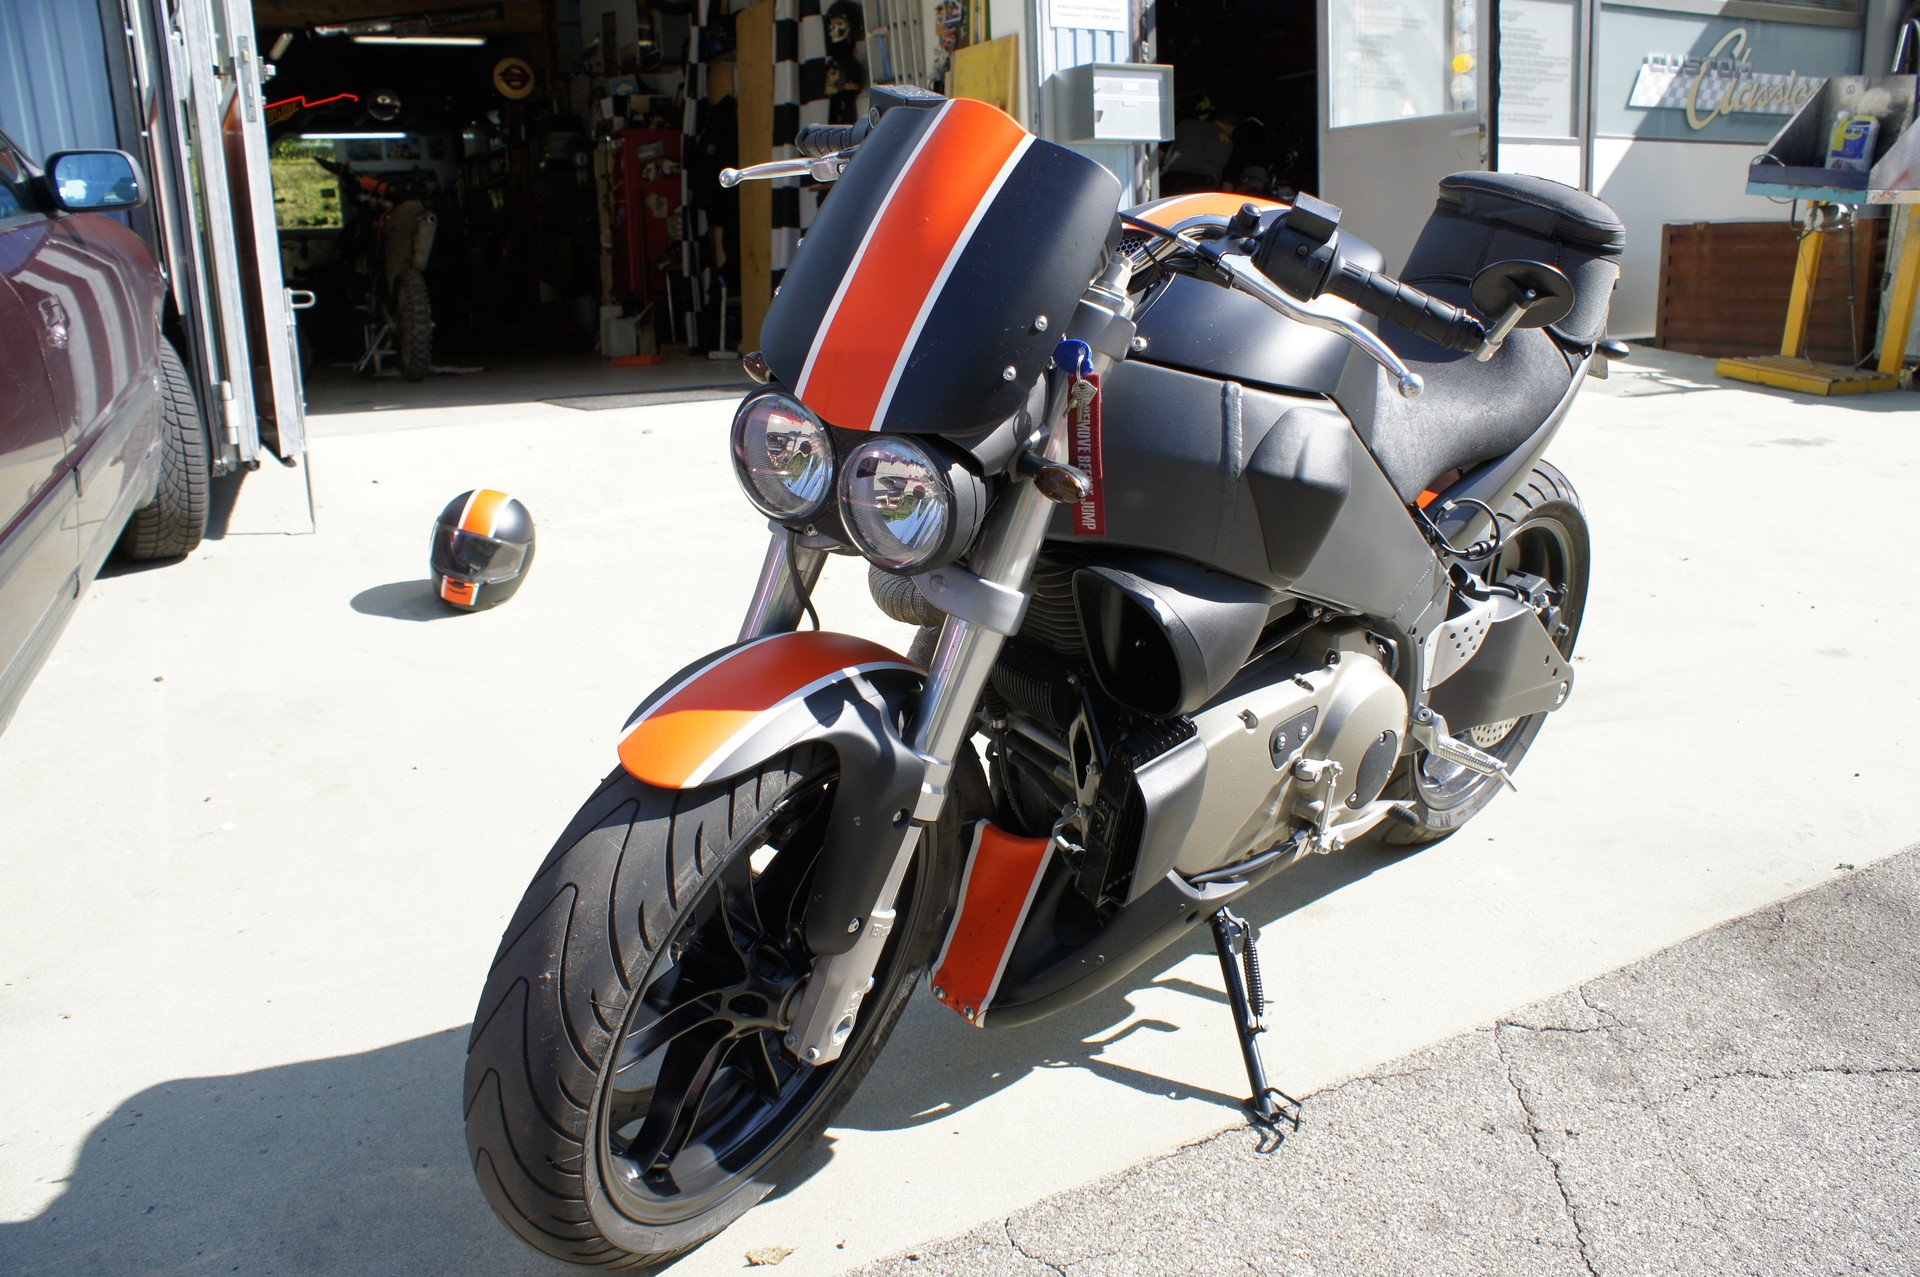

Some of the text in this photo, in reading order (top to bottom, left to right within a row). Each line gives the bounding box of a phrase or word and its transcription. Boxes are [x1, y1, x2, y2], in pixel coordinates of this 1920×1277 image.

[1648, 52, 1753, 79] CUSTOM
[1077, 455, 1094, 495] BEF
[1080, 498, 1097, 530] JUMP
